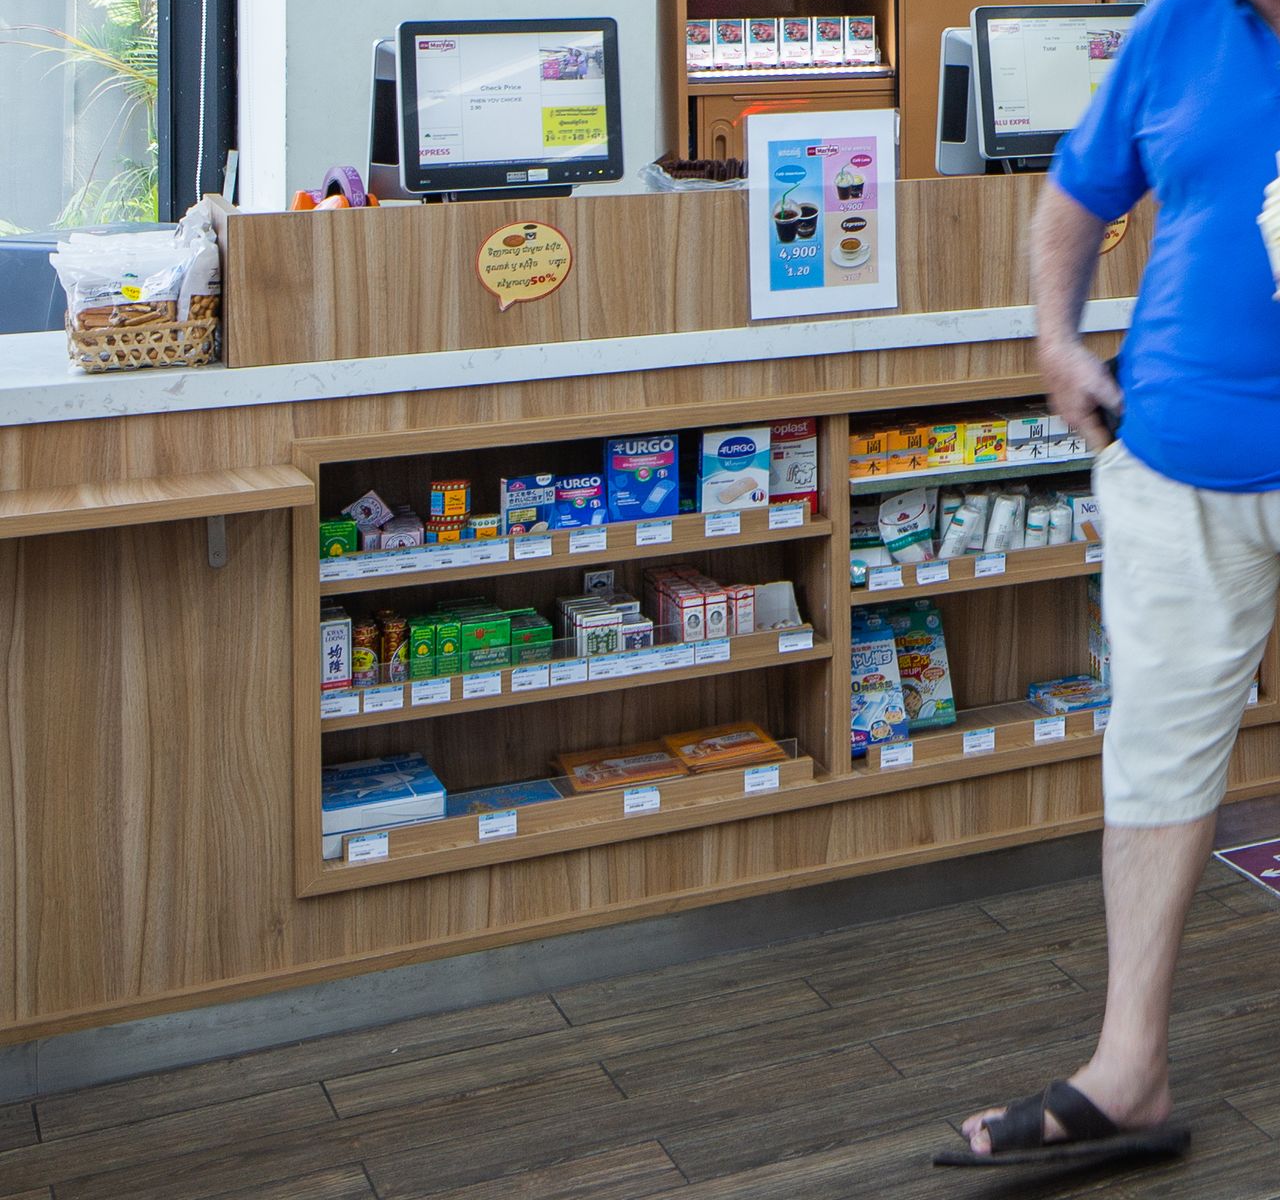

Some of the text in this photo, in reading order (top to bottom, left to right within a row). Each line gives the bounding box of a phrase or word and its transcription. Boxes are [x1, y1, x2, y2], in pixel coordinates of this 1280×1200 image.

[625, 438, 674, 455] URGO
[724, 443, 755, 455] URGO
[562, 476, 601, 490] URGO
